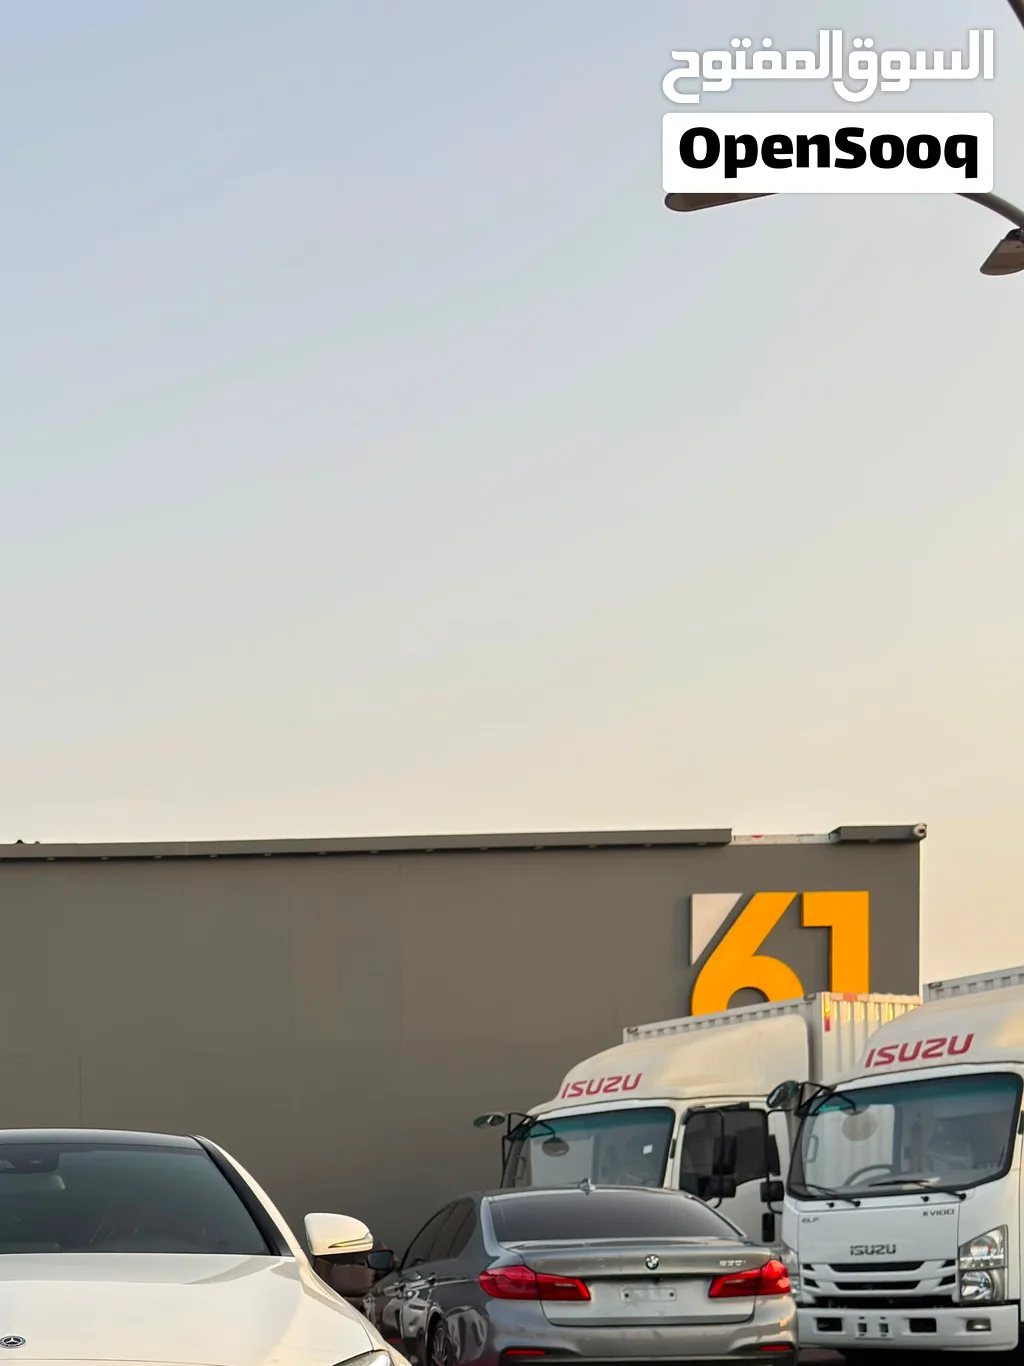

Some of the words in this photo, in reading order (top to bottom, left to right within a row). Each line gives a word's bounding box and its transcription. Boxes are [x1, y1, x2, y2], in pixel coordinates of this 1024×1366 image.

[691, 890, 870, 1017] 61
[864, 1033, 975, 1069] ISUZU
[561, 1072, 643, 1099] ISUZU
[849, 1243, 897, 1257] ISUZU
